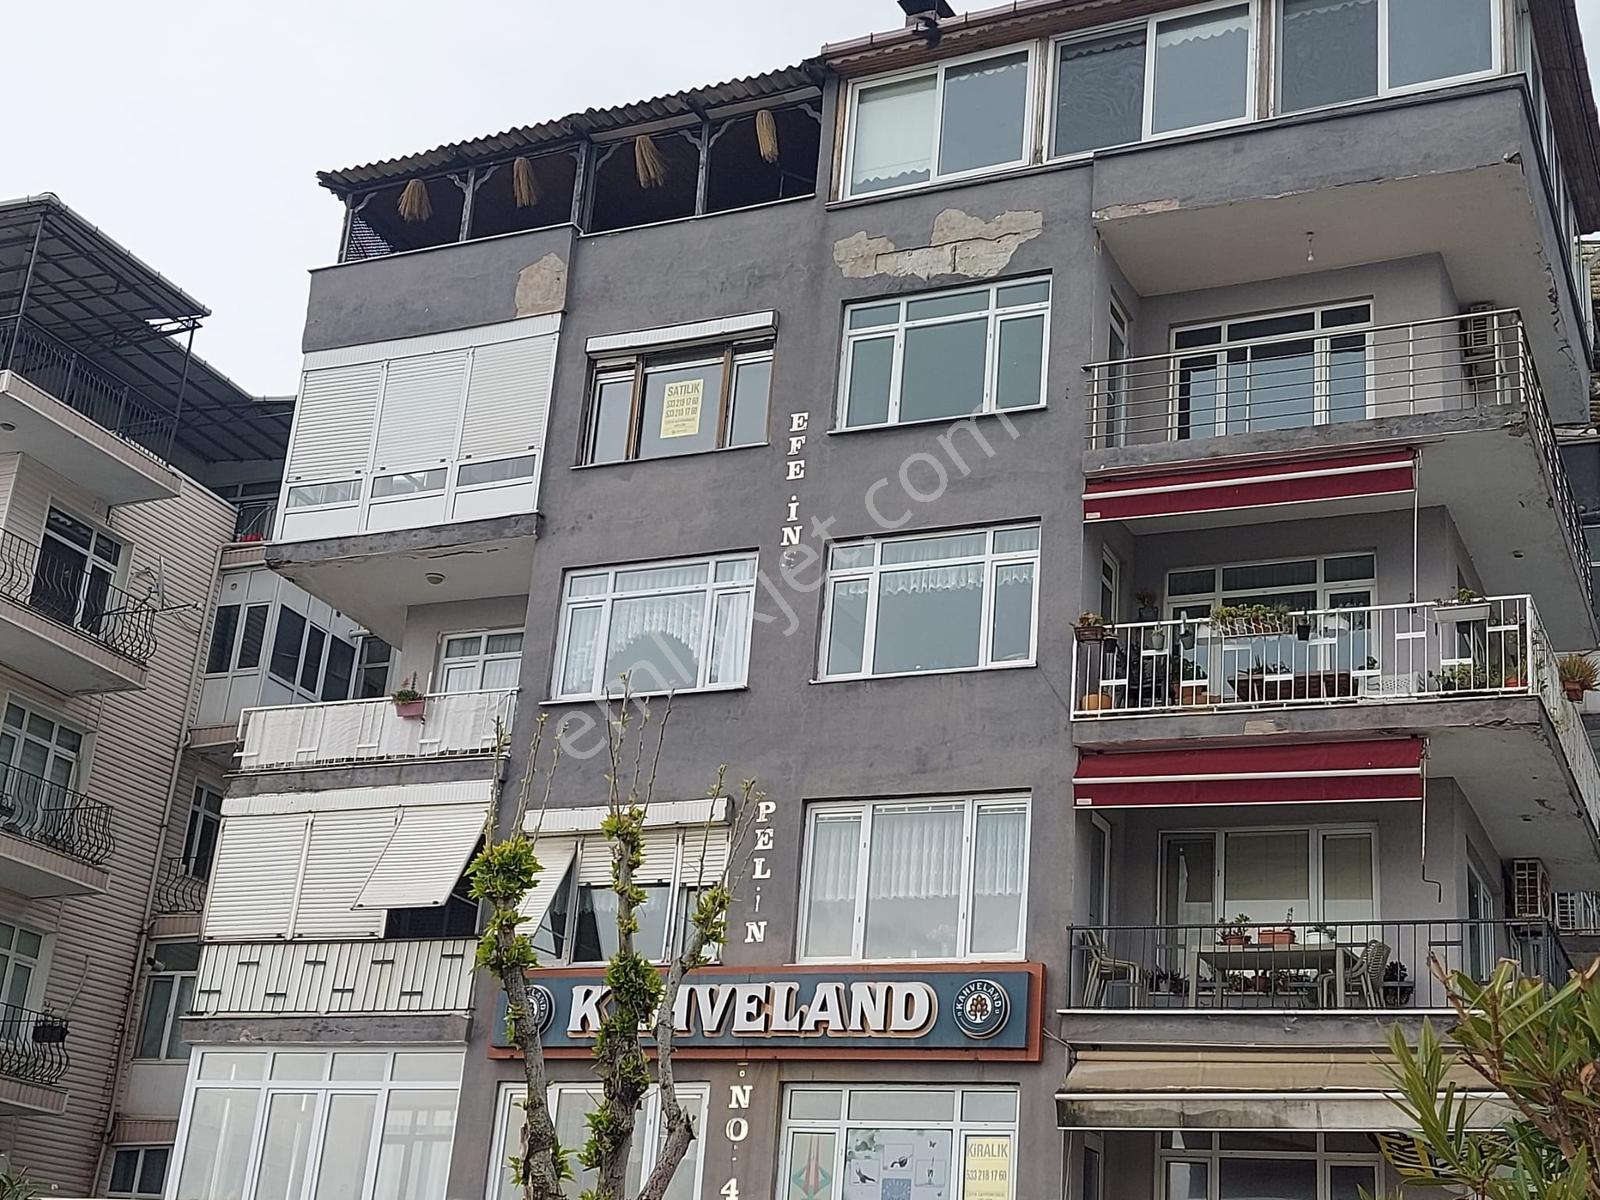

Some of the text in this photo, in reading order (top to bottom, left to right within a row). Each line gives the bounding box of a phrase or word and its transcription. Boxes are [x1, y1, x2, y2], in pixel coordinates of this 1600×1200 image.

[667, 383, 700, 397] SATILIK
[786, 412, 809, 481] EFE
[567, 982, 937, 1037] KHVELAND
[956, 982, 1002, 1010] KAHVELAND
